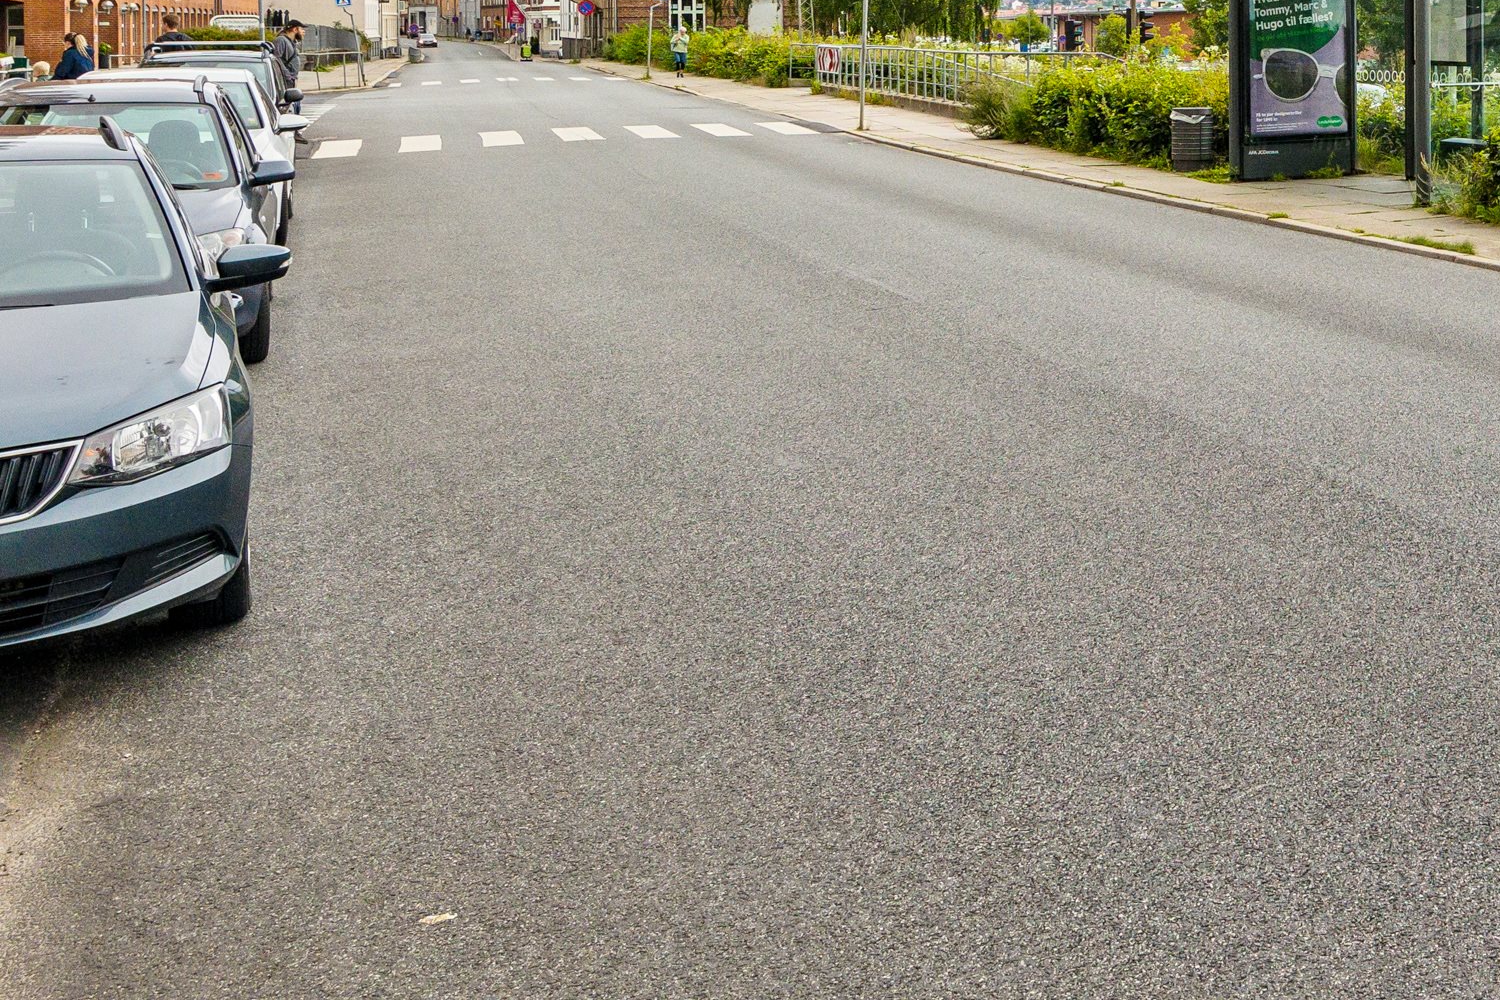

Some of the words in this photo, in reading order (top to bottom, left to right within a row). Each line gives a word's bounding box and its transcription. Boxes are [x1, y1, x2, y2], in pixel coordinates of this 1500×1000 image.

[1254, 5, 1292, 17] Tommy,
[1294, 1, 1319, 12] Marc
[1321, 0, 1328, 8] &
[1256, 19, 1283, 31] Hugo
[1286, 16, 1297, 26] til
[1299, 11, 1334, 25] fælles?
